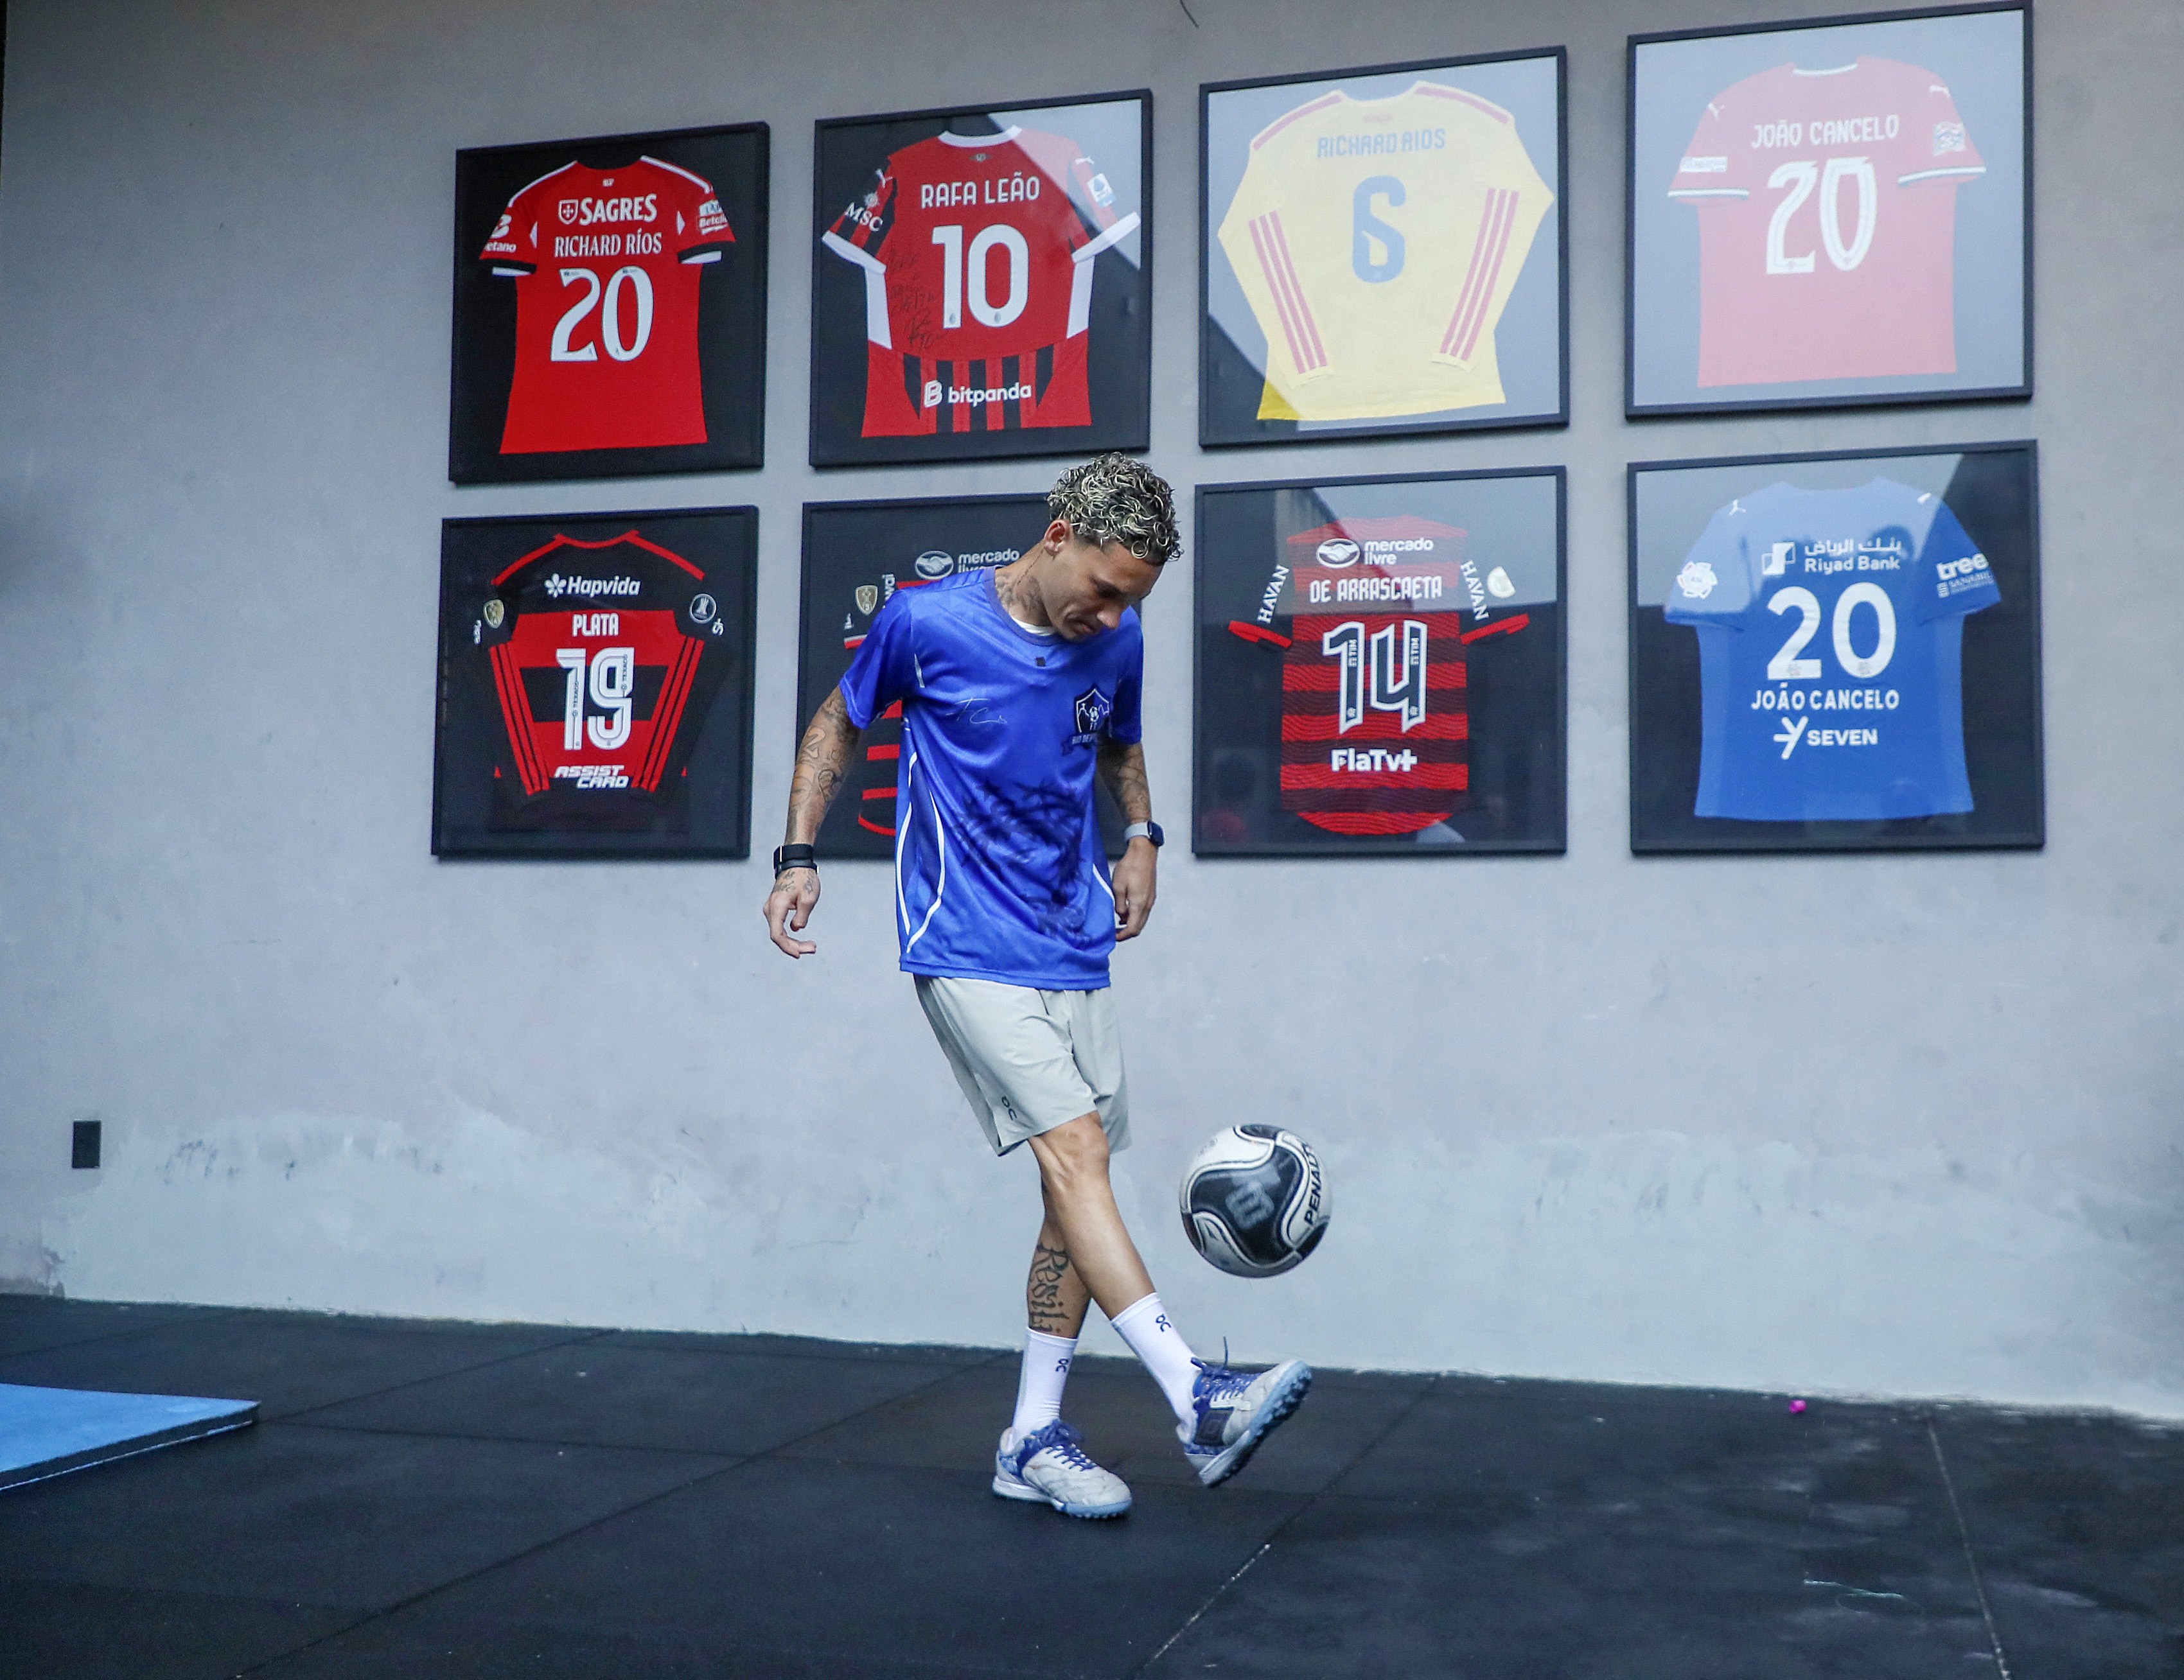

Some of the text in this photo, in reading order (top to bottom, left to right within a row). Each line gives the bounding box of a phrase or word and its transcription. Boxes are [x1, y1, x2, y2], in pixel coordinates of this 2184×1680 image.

[1751, 114, 1899, 149] JOÃO CANCELO
[920, 171, 1041, 209] RAFA LEÃO
[579, 193, 658, 225] SAGRES
[843, 202, 884, 232] MSC
[1766, 156, 1878, 275] 20
[554, 227, 662, 258] RICHARD RÍOS
[1352, 175, 1406, 283] 6
[931, 223, 1030, 329] 10
[550, 265, 655, 362] 20
[948, 381, 1032, 408] bitpanda
[957, 548, 1020, 565] mercado
[1364, 538, 1434, 552] mercado
[1364, 552, 1397, 566] livre
[1804, 556, 1901, 575] Riyad Bank
[1936, 552, 1989, 581] tree
[567, 575, 641, 598] Hapvida
[1257, 564, 1290, 625] HAVAN
[1309, 576, 1443, 604] DE ARRASCAETA
[1459, 560, 1490, 621] HAVAN
[572, 613, 619, 637] PLATA
[1767, 582, 1896, 680] 20
[1323, 620, 1428, 735] 14
[556, 647, 635, 751] 19
[1751, 681, 1900, 711] JOÃO CANCELO
[1807, 728, 1878, 747] SEVEN
[554, 764, 625, 778] ASSIST
[1331, 747, 1418, 772] FlaTv+
